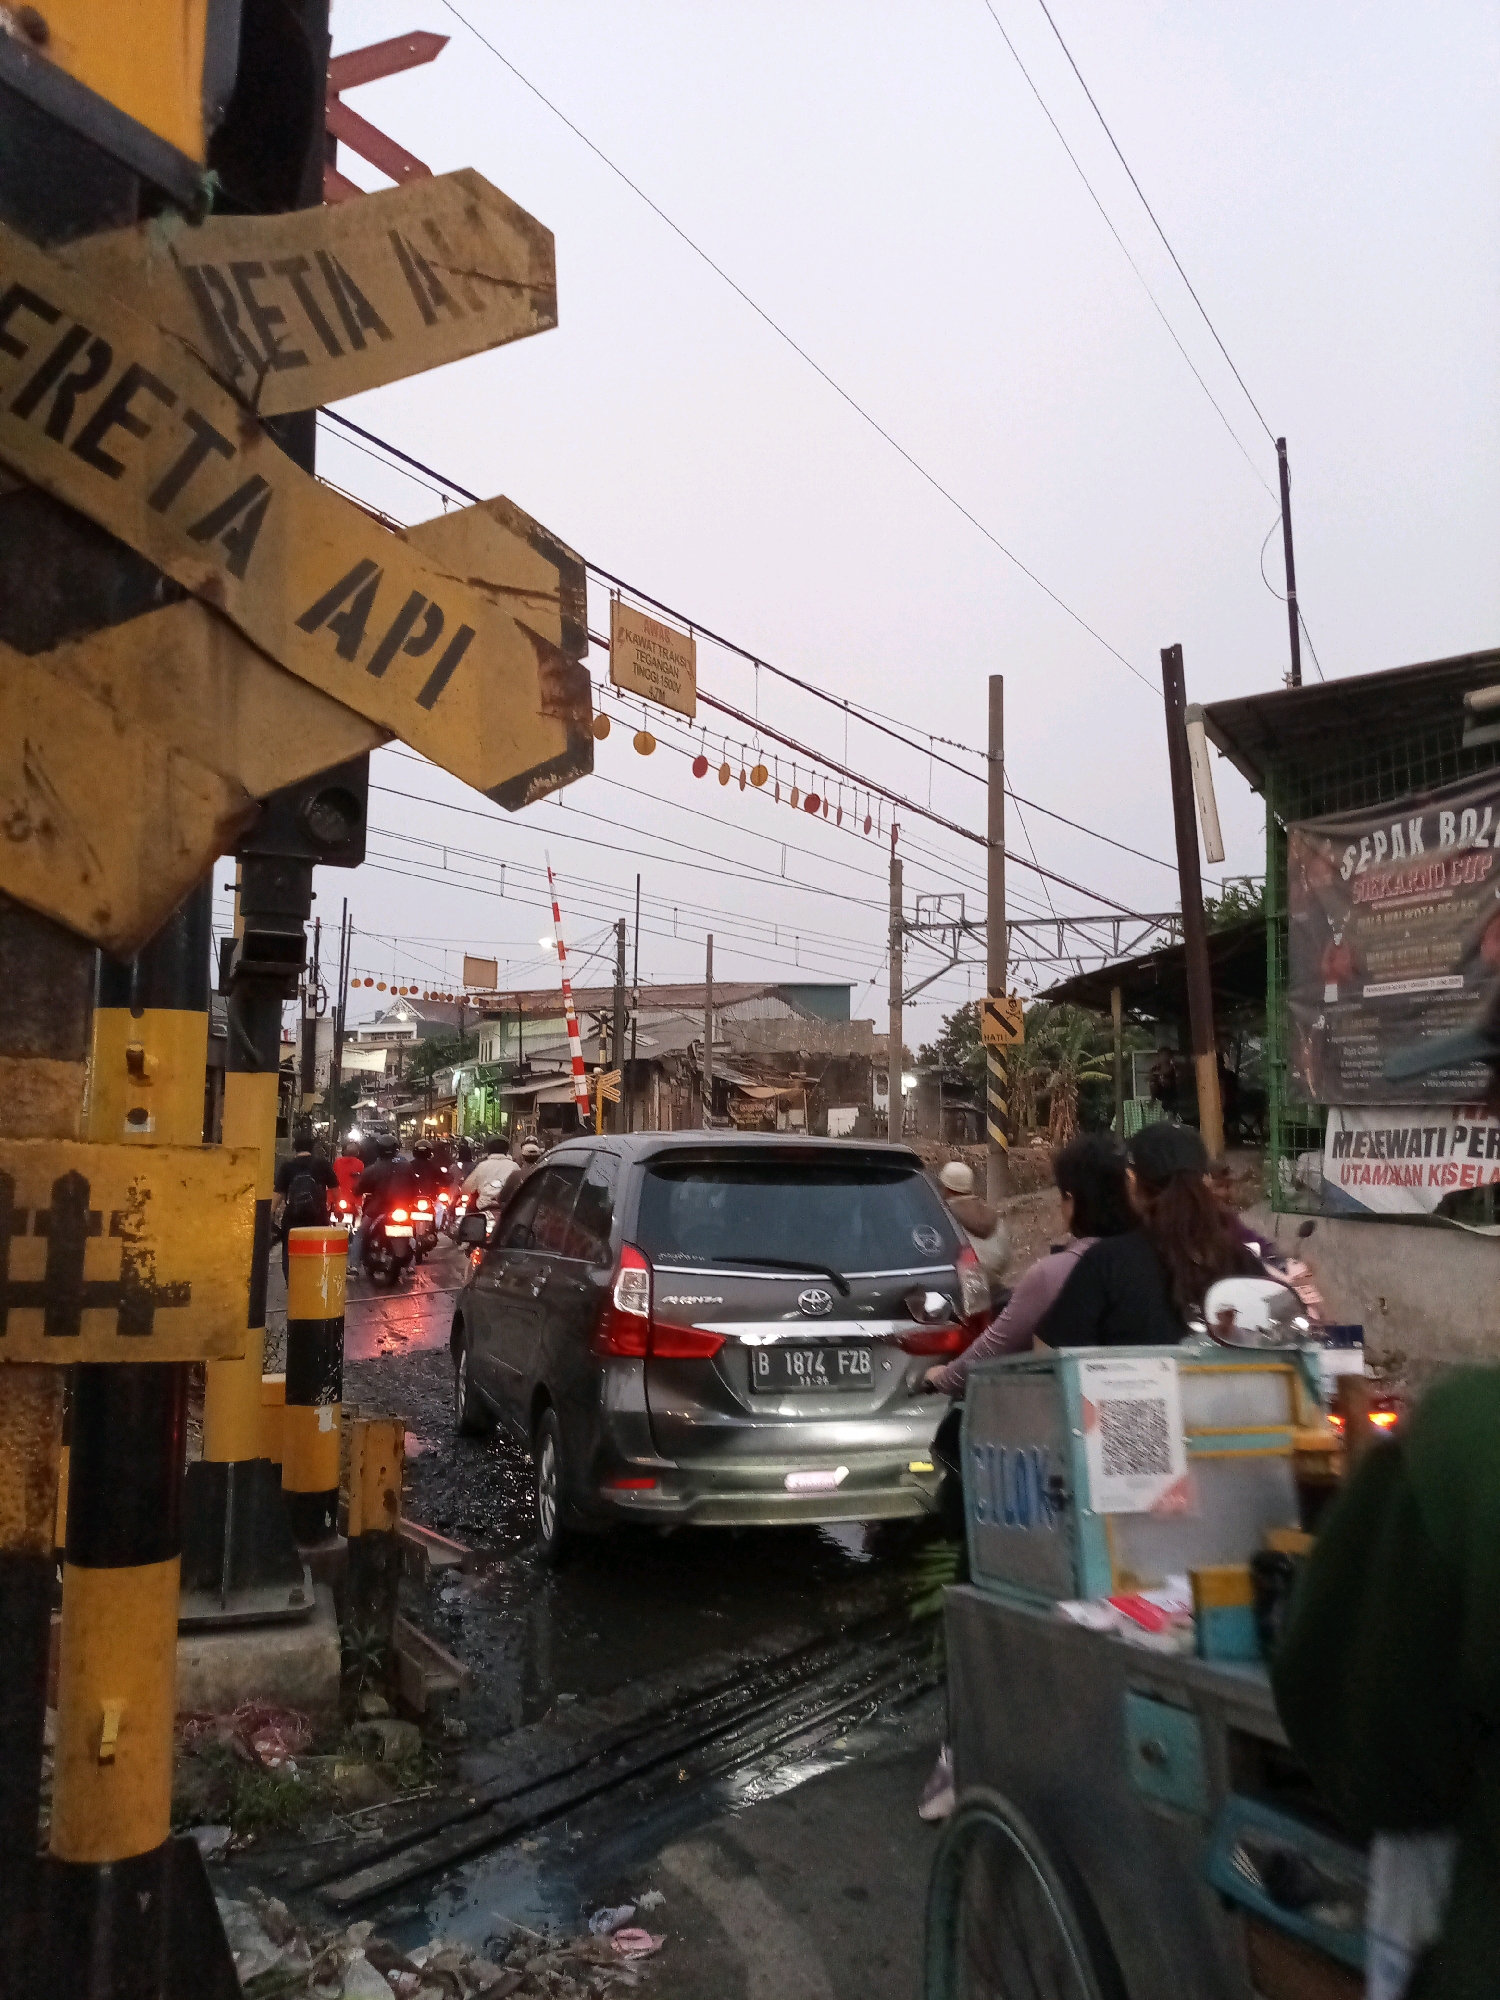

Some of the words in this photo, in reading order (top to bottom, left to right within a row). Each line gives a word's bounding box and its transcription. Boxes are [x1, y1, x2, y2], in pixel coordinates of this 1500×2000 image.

[294, 558, 476, 710] API
[632, 661, 660, 684] TINGGI
[635, 648, 679, 679] TEGANGAN
[1340, 816, 1425, 881] SEPAK
[1451, 855, 1493, 886] CUP
[758, 1351, 770, 1376] B
[837, 1350, 871, 1375] FZB
